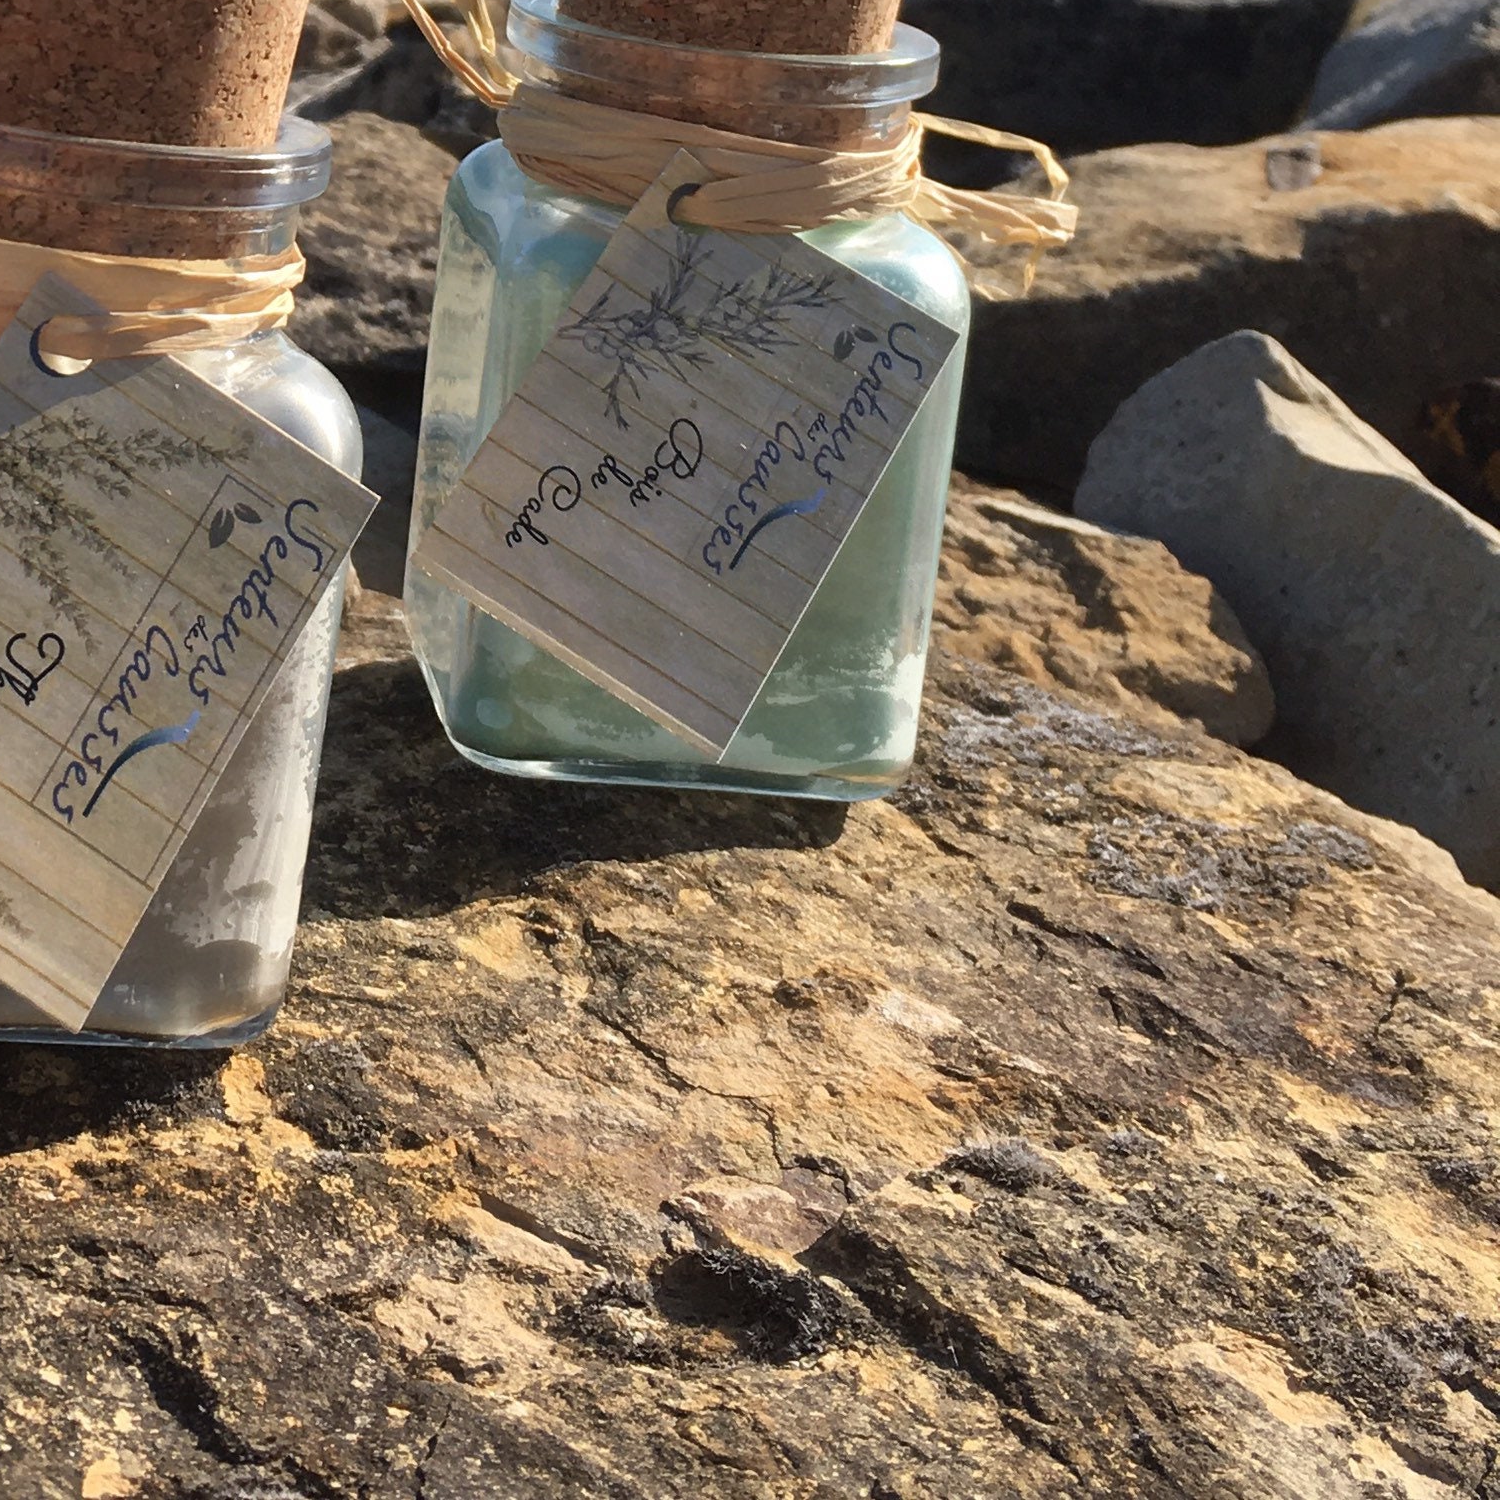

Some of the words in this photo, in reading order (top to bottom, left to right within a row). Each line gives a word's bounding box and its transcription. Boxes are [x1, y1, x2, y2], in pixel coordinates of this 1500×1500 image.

[591, 454, 634, 502] de
[629, 418, 703, 507] Bois
[814, 322, 923, 486] Senteurs
[506, 465, 582, 549] Cade
[702, 420, 805, 575] Causses
[187, 499, 322, 710] Senteurs
[52, 625, 178, 824] Causses
